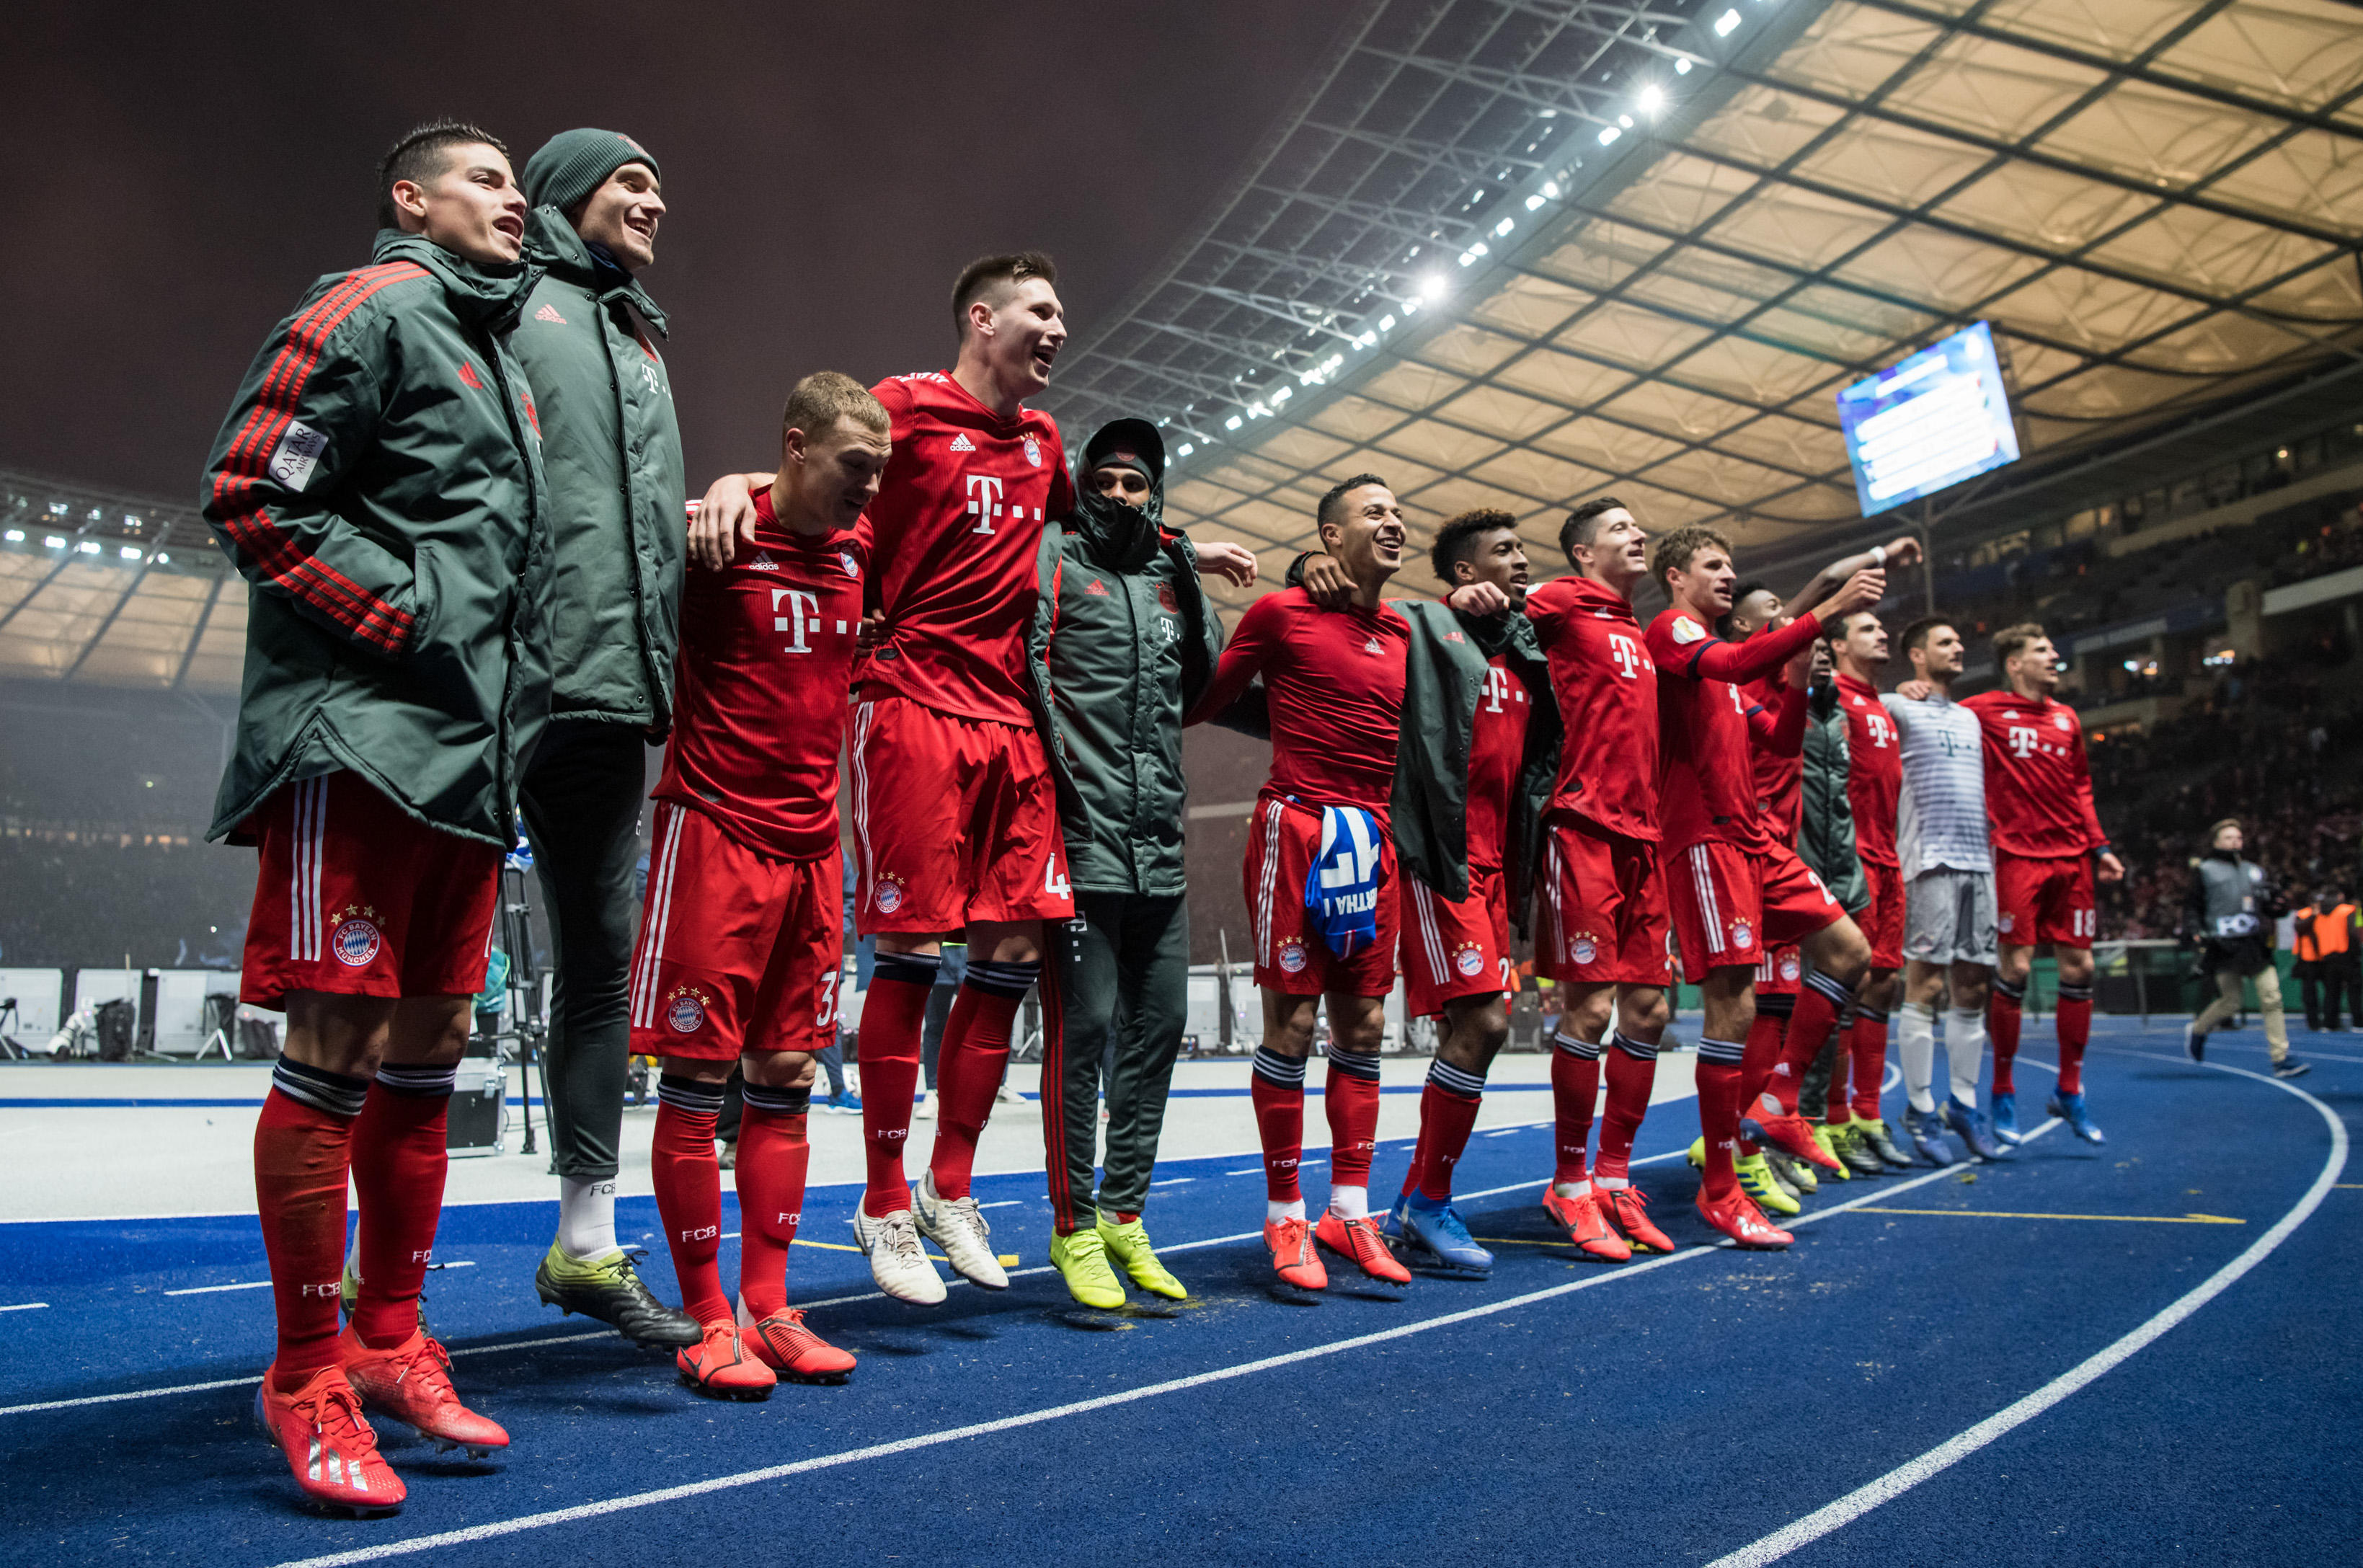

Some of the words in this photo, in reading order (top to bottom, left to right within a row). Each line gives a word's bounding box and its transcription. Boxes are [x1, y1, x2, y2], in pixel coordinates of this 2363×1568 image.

[276, 428, 311, 480] QATAR
[296, 433, 321, 474] AIRWAYS
[748, 562, 779, 571] adidas
[1045, 852, 1071, 900] 4
[338, 929, 348, 939] FC
[348, 923, 377, 941] BAYERN
[2074, 909, 2096, 938] 18
[878, 1128, 907, 1139] FCB
[1272, 1158, 1298, 1168] FCB
[682, 1225, 717, 1243] FCB
[303, 1281, 342, 1298] FCB
